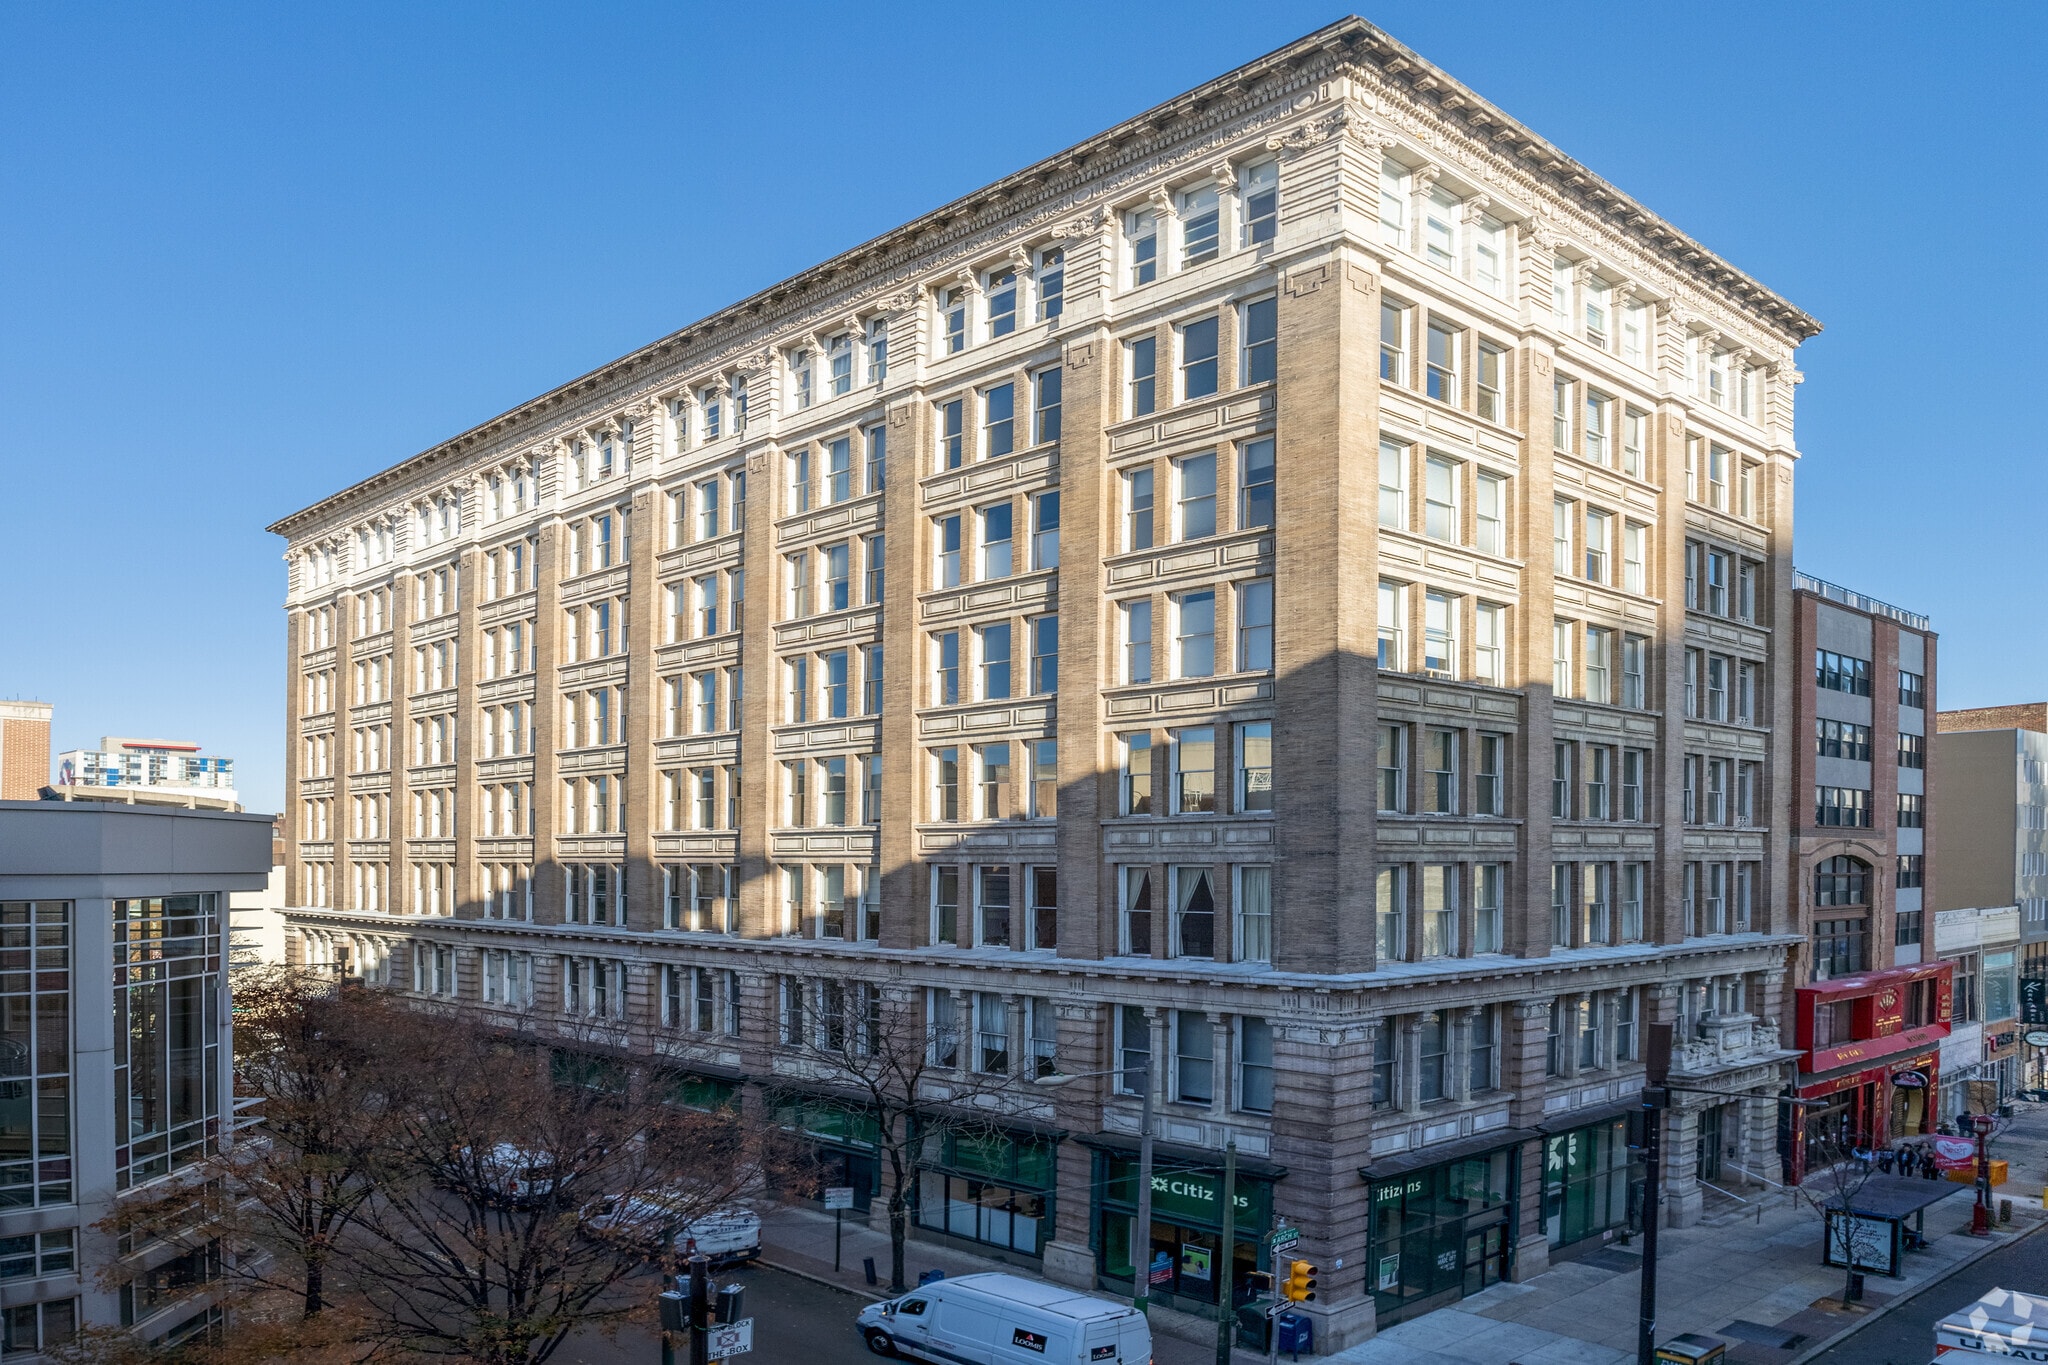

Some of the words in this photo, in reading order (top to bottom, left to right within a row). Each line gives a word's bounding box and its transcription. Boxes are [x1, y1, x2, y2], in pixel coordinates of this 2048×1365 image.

[1170, 1181, 1249, 1207] Citizs
[1376, 1180, 1422, 1202] itizns
[708, 1349, 725, 1359] THE
[729, 1343, 749, 1354] BOX
[1014, 1336, 1044, 1351] LOOMIS
[1092, 1350, 1115, 1360] LOOMIS
